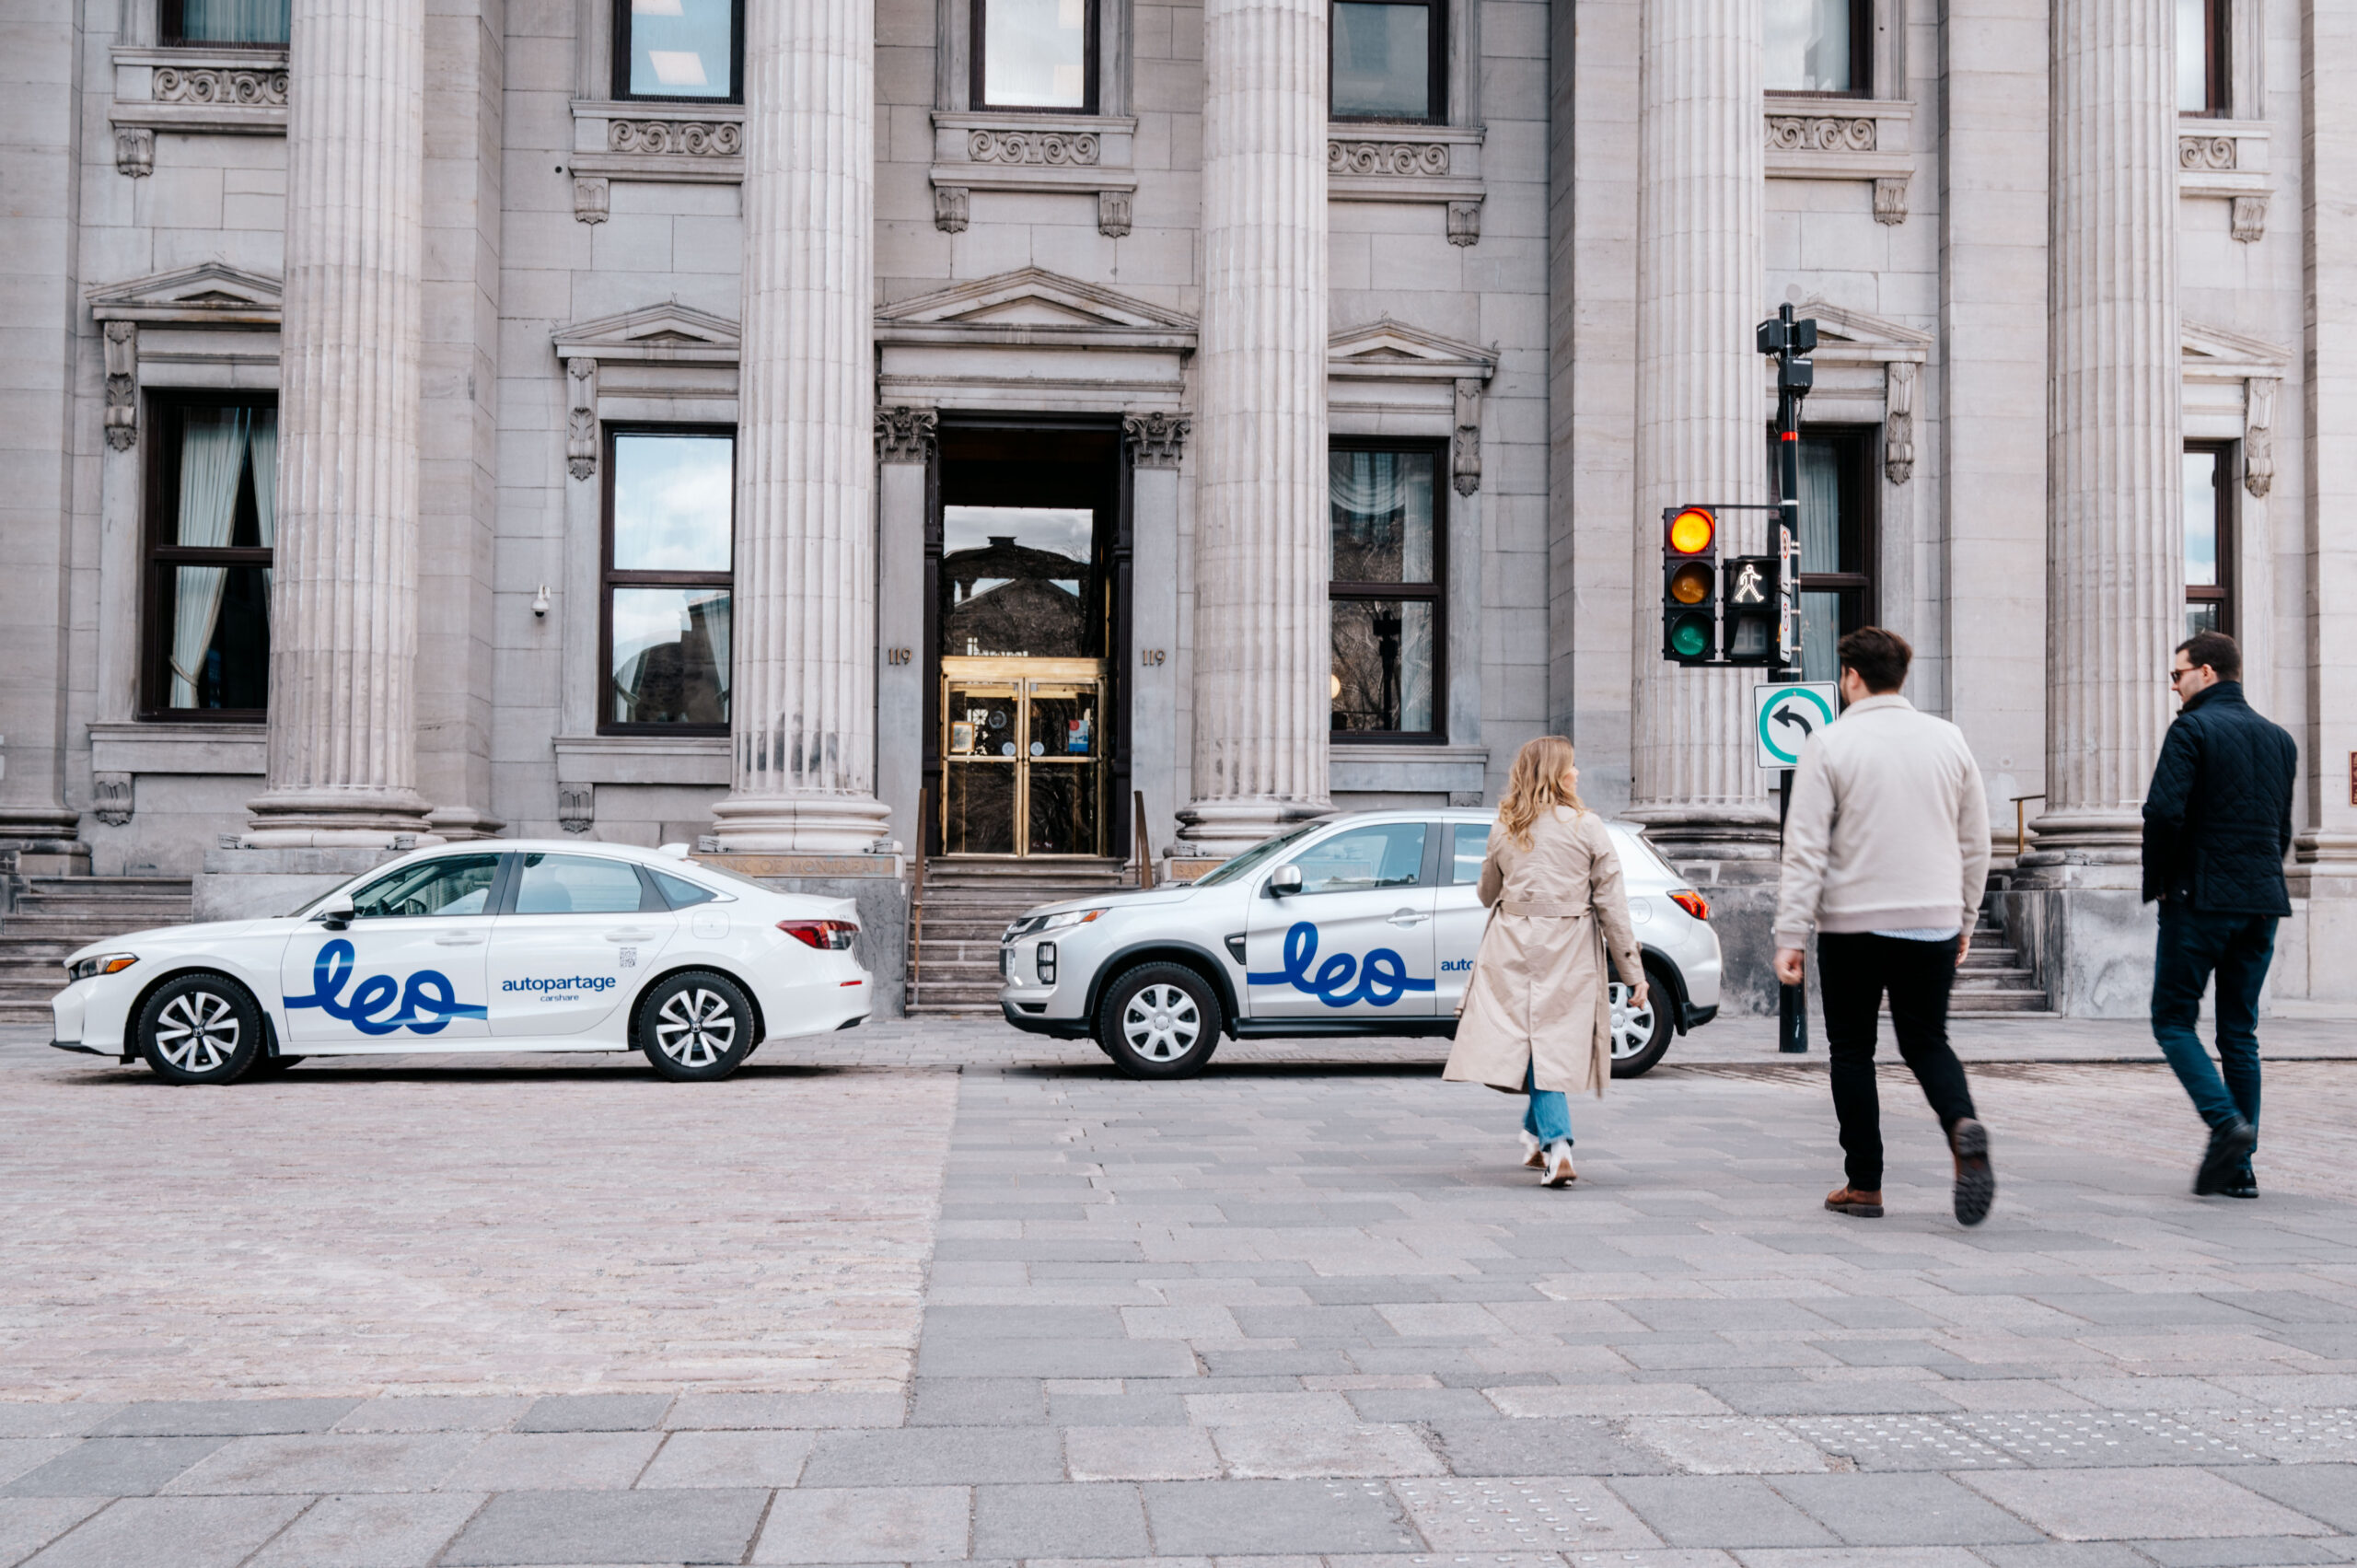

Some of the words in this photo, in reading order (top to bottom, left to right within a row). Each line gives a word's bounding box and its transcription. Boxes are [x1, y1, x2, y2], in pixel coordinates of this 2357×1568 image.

[888, 648, 912, 665] 119
[1143, 649, 1165, 666] 119
[790, 860, 884, 874] MONTREAL
[1247, 921, 1435, 1007] leo
[283, 938, 487, 1035] leo
[502, 976, 616, 993] autopartage
